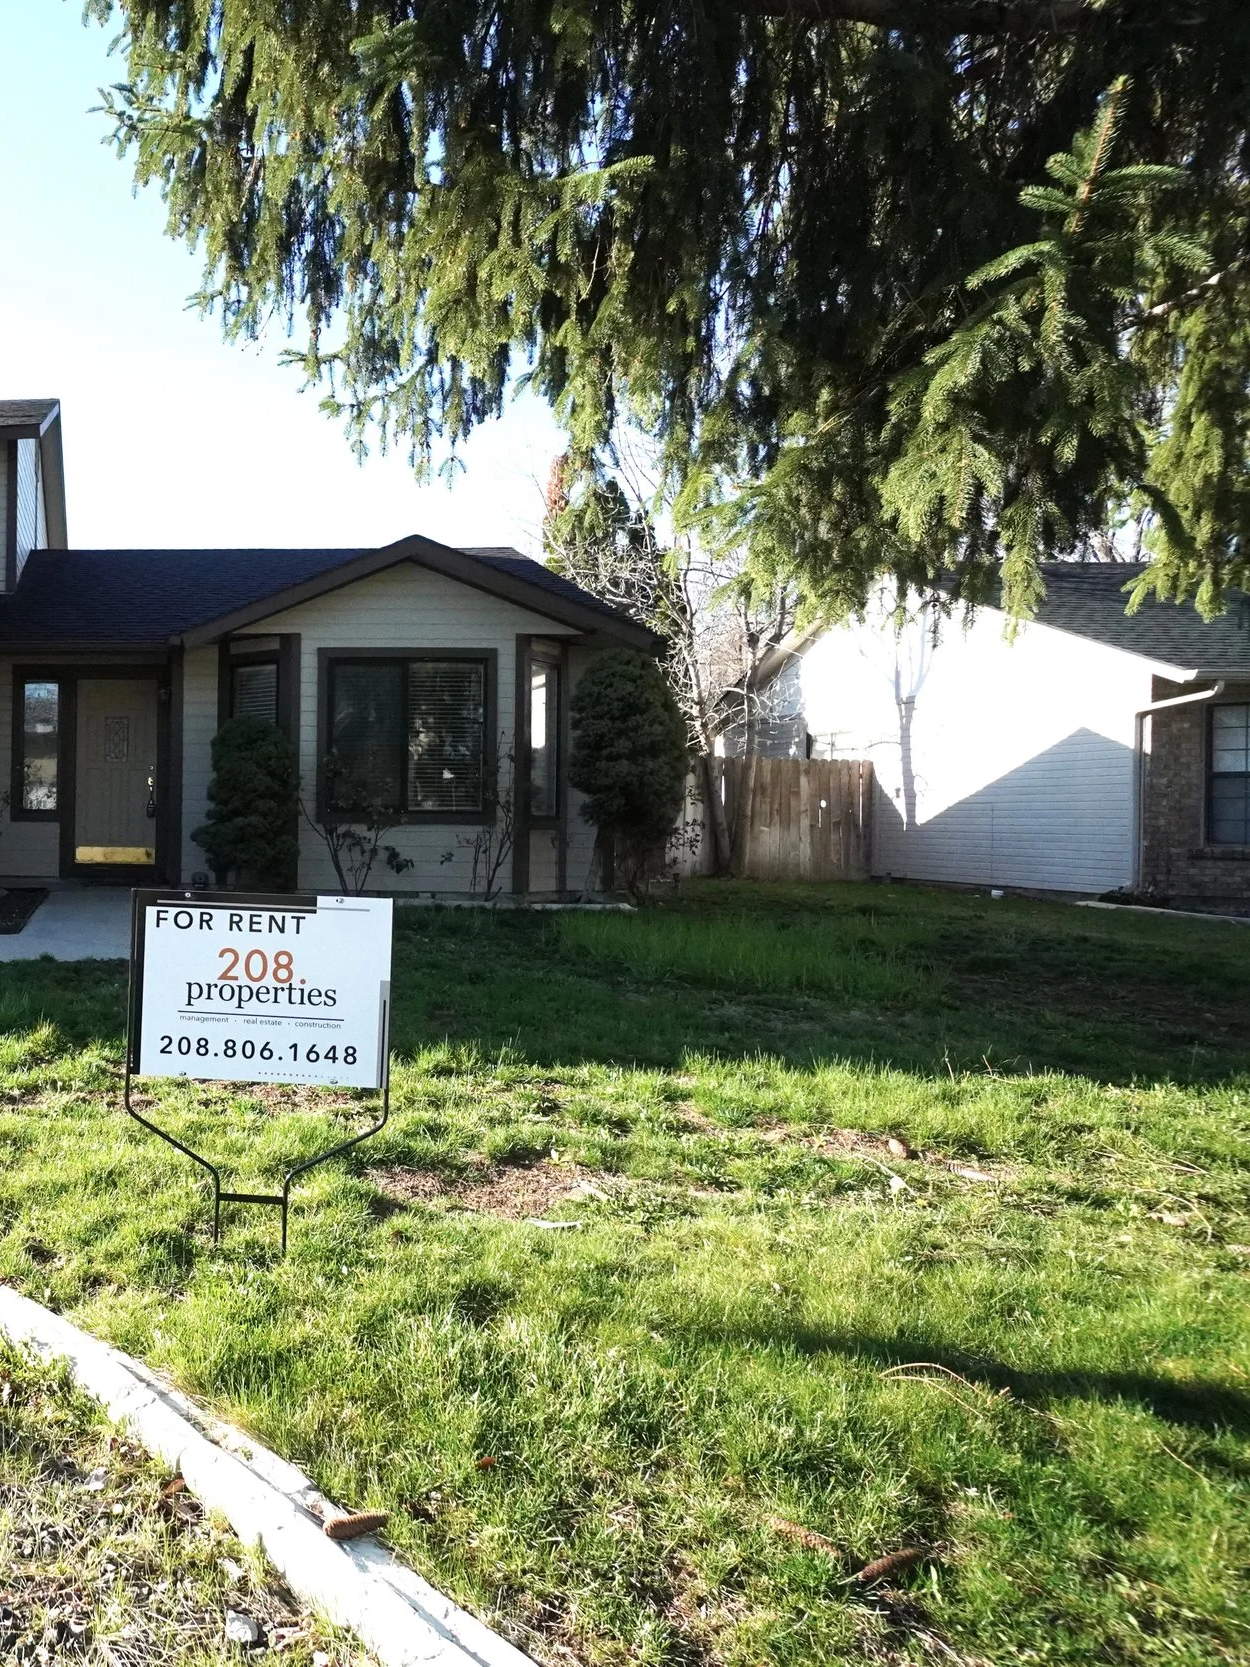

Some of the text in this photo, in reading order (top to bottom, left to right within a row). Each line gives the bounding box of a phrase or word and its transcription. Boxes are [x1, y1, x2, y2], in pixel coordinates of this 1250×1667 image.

[155, 909, 306, 935] FOR RENT
[217, 947, 307, 985] 208.
[185, 981, 338, 1010] properties
[179, 1014, 343, 1030] management real estate construction
[159, 1035, 359, 1066] 208.806.1648
